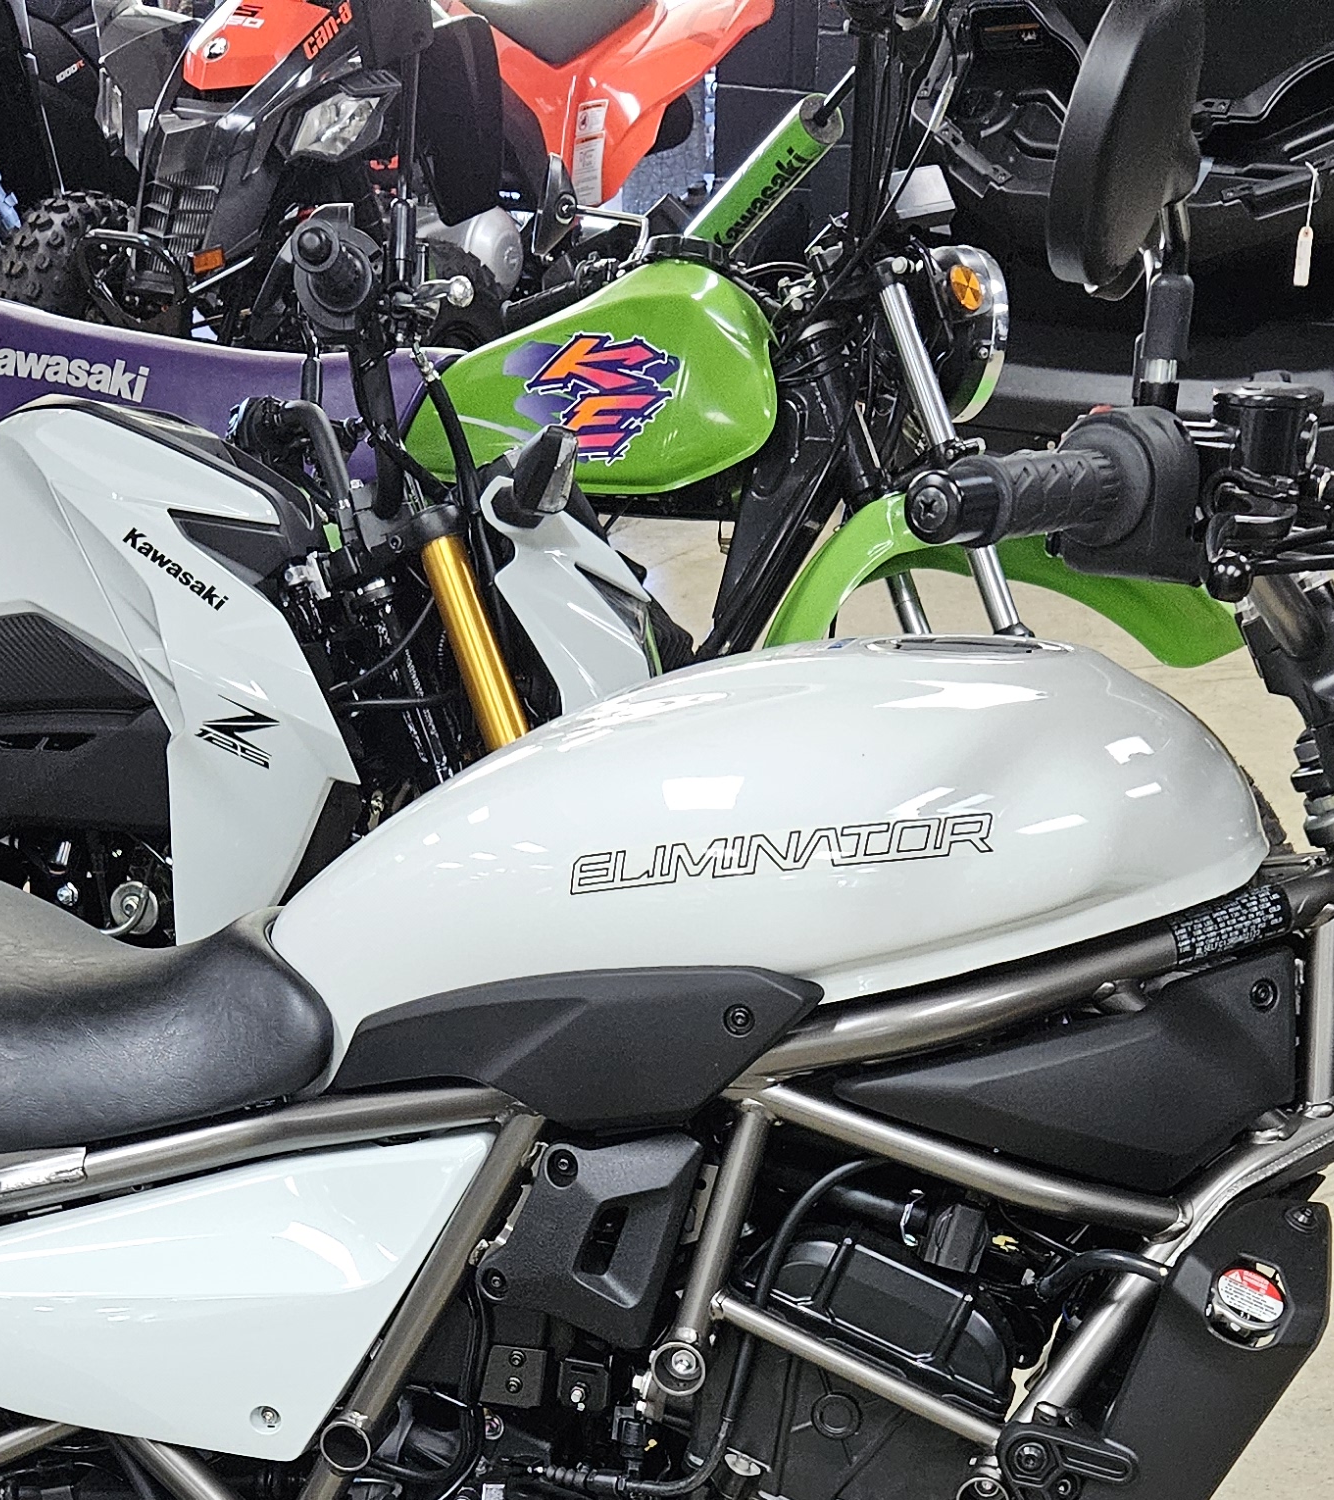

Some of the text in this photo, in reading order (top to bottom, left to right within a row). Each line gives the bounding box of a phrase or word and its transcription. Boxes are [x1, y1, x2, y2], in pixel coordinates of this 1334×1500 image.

[302, 2, 353, 60] can-a
[122, 527, 229, 611] Kawasaki
[570, 812, 994, 895] ELIMINATOR
